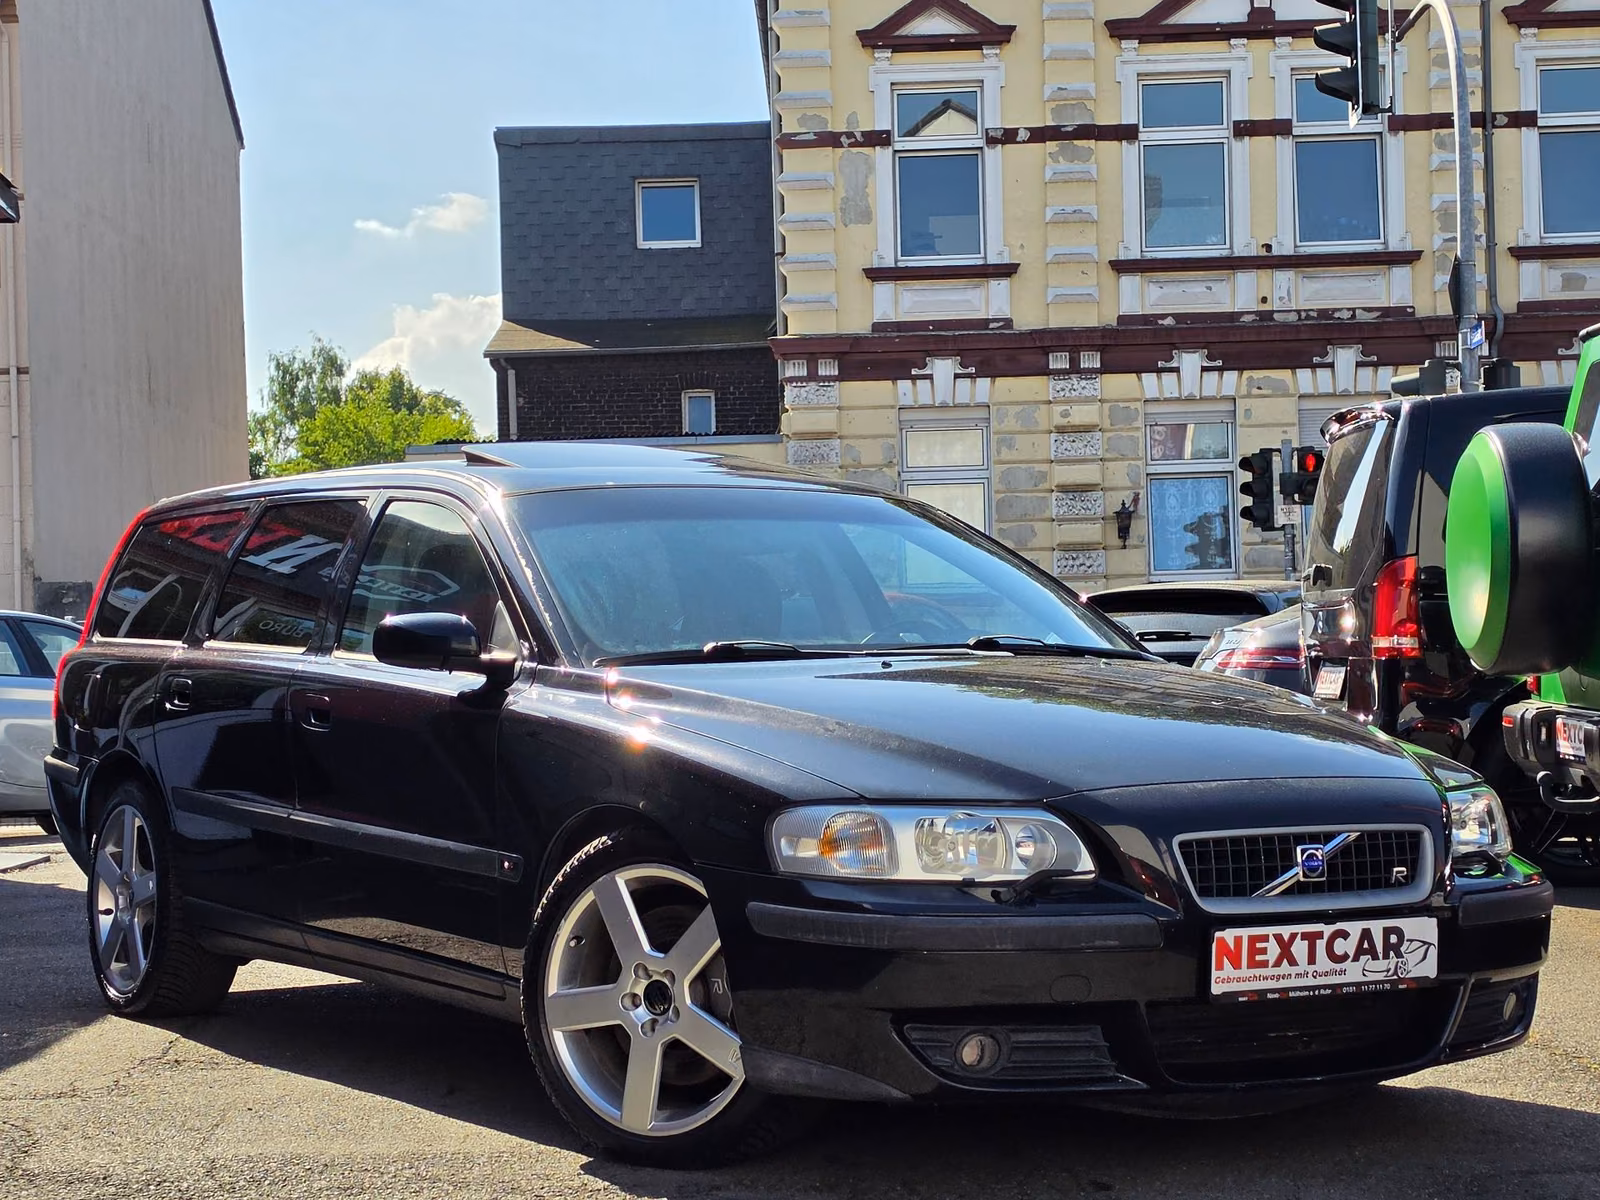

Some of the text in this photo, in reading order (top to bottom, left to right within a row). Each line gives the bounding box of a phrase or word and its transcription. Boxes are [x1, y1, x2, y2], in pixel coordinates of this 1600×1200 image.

[1391, 867, 1407, 883] R
[1214, 926, 1406, 971] NEXTCAR
[1214, 968, 1347, 985] Gebrauchtwagen mit Qualität
